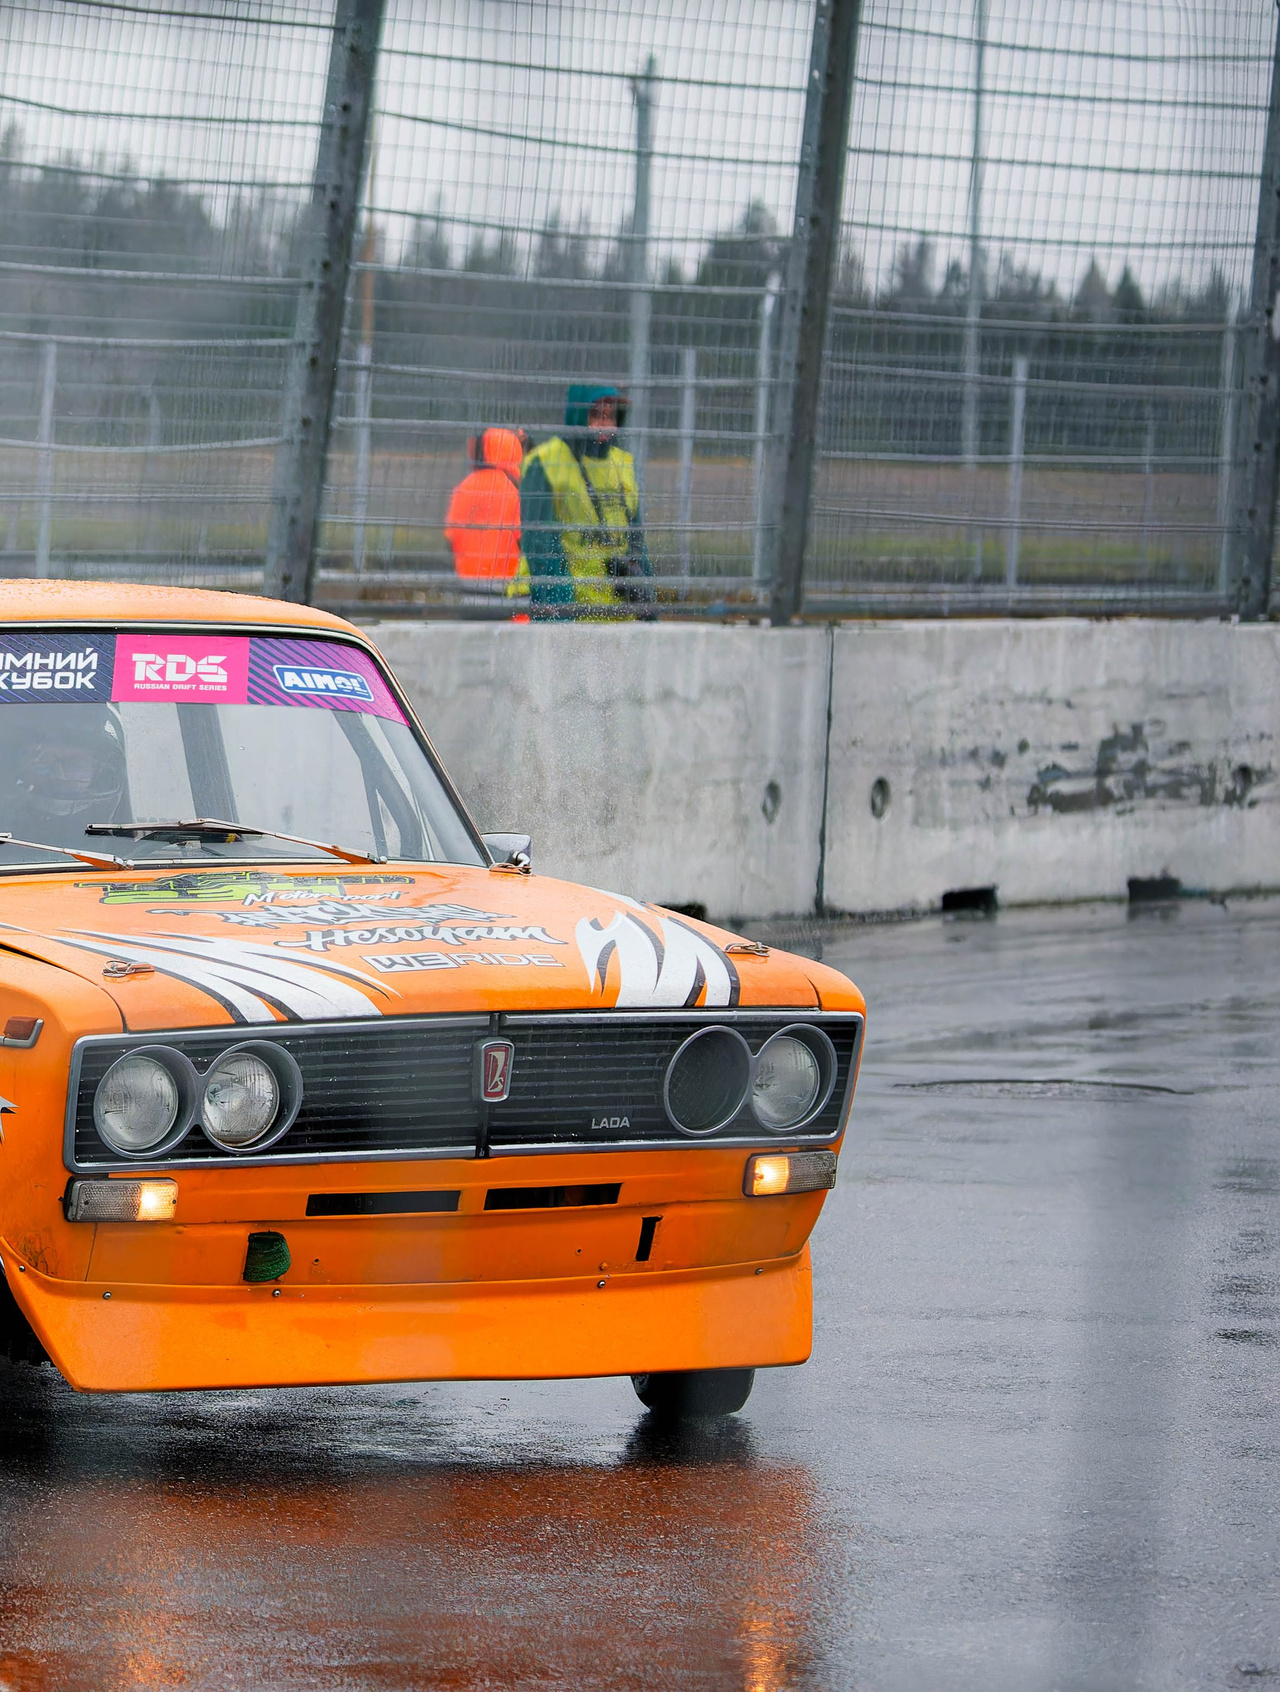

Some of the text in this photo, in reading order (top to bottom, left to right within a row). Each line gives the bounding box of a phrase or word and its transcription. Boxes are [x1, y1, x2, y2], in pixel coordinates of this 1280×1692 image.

[132, 653, 228, 682] RDS
[274, 926, 568, 951] Hesoyam
[591, 1117, 630, 1130] LADA
